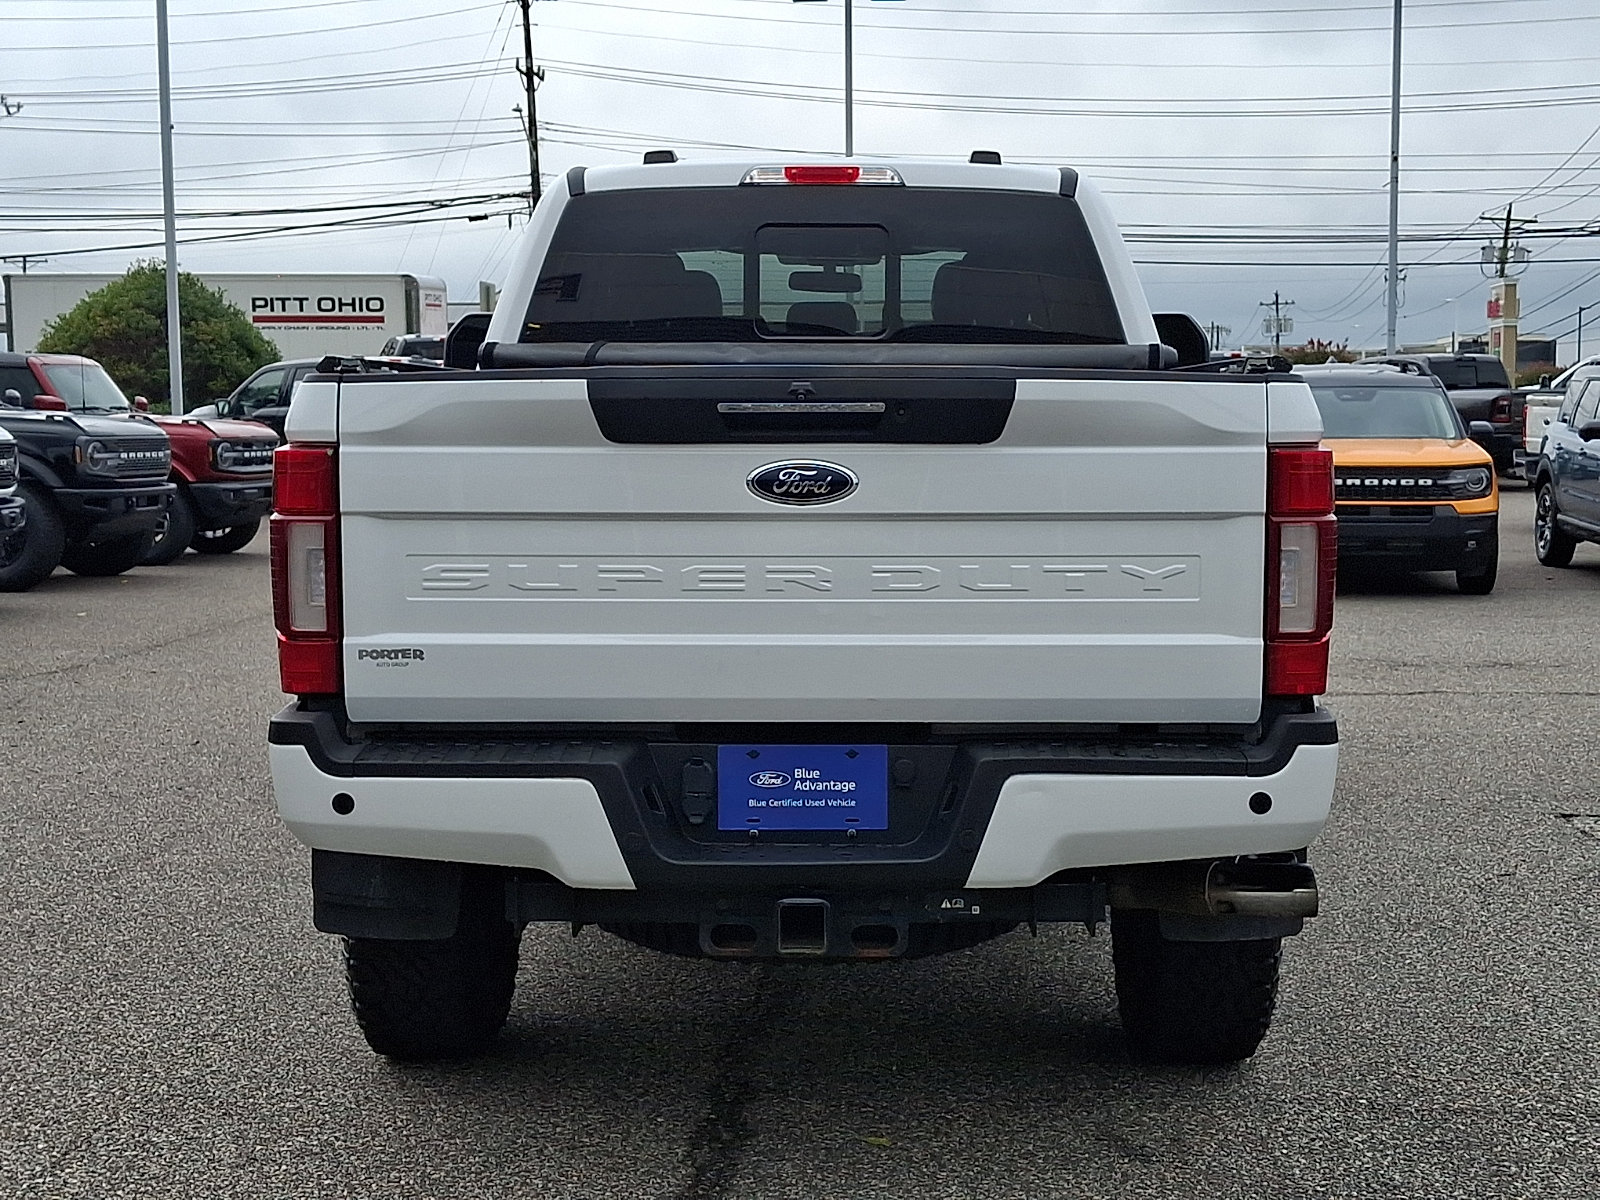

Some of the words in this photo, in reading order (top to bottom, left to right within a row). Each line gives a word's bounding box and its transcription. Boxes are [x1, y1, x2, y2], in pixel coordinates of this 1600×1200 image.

[251, 297, 309, 313] PITT
[317, 296, 385, 313] OHIO
[772, 468, 833, 494] Ford
[421, 564, 832, 592] SUPER
[871, 565, 1187, 592] DUTY
[357, 648, 425, 660] PORTER
[756, 773, 783, 785] Ford
[794, 768, 820, 779] Blue
[793, 780, 856, 792] Advantage
[748, 799, 767, 807] Blue
[768, 799, 803, 807] Certified
[804, 799, 826, 807] Used
[827, 799, 857, 807] Vehicle
